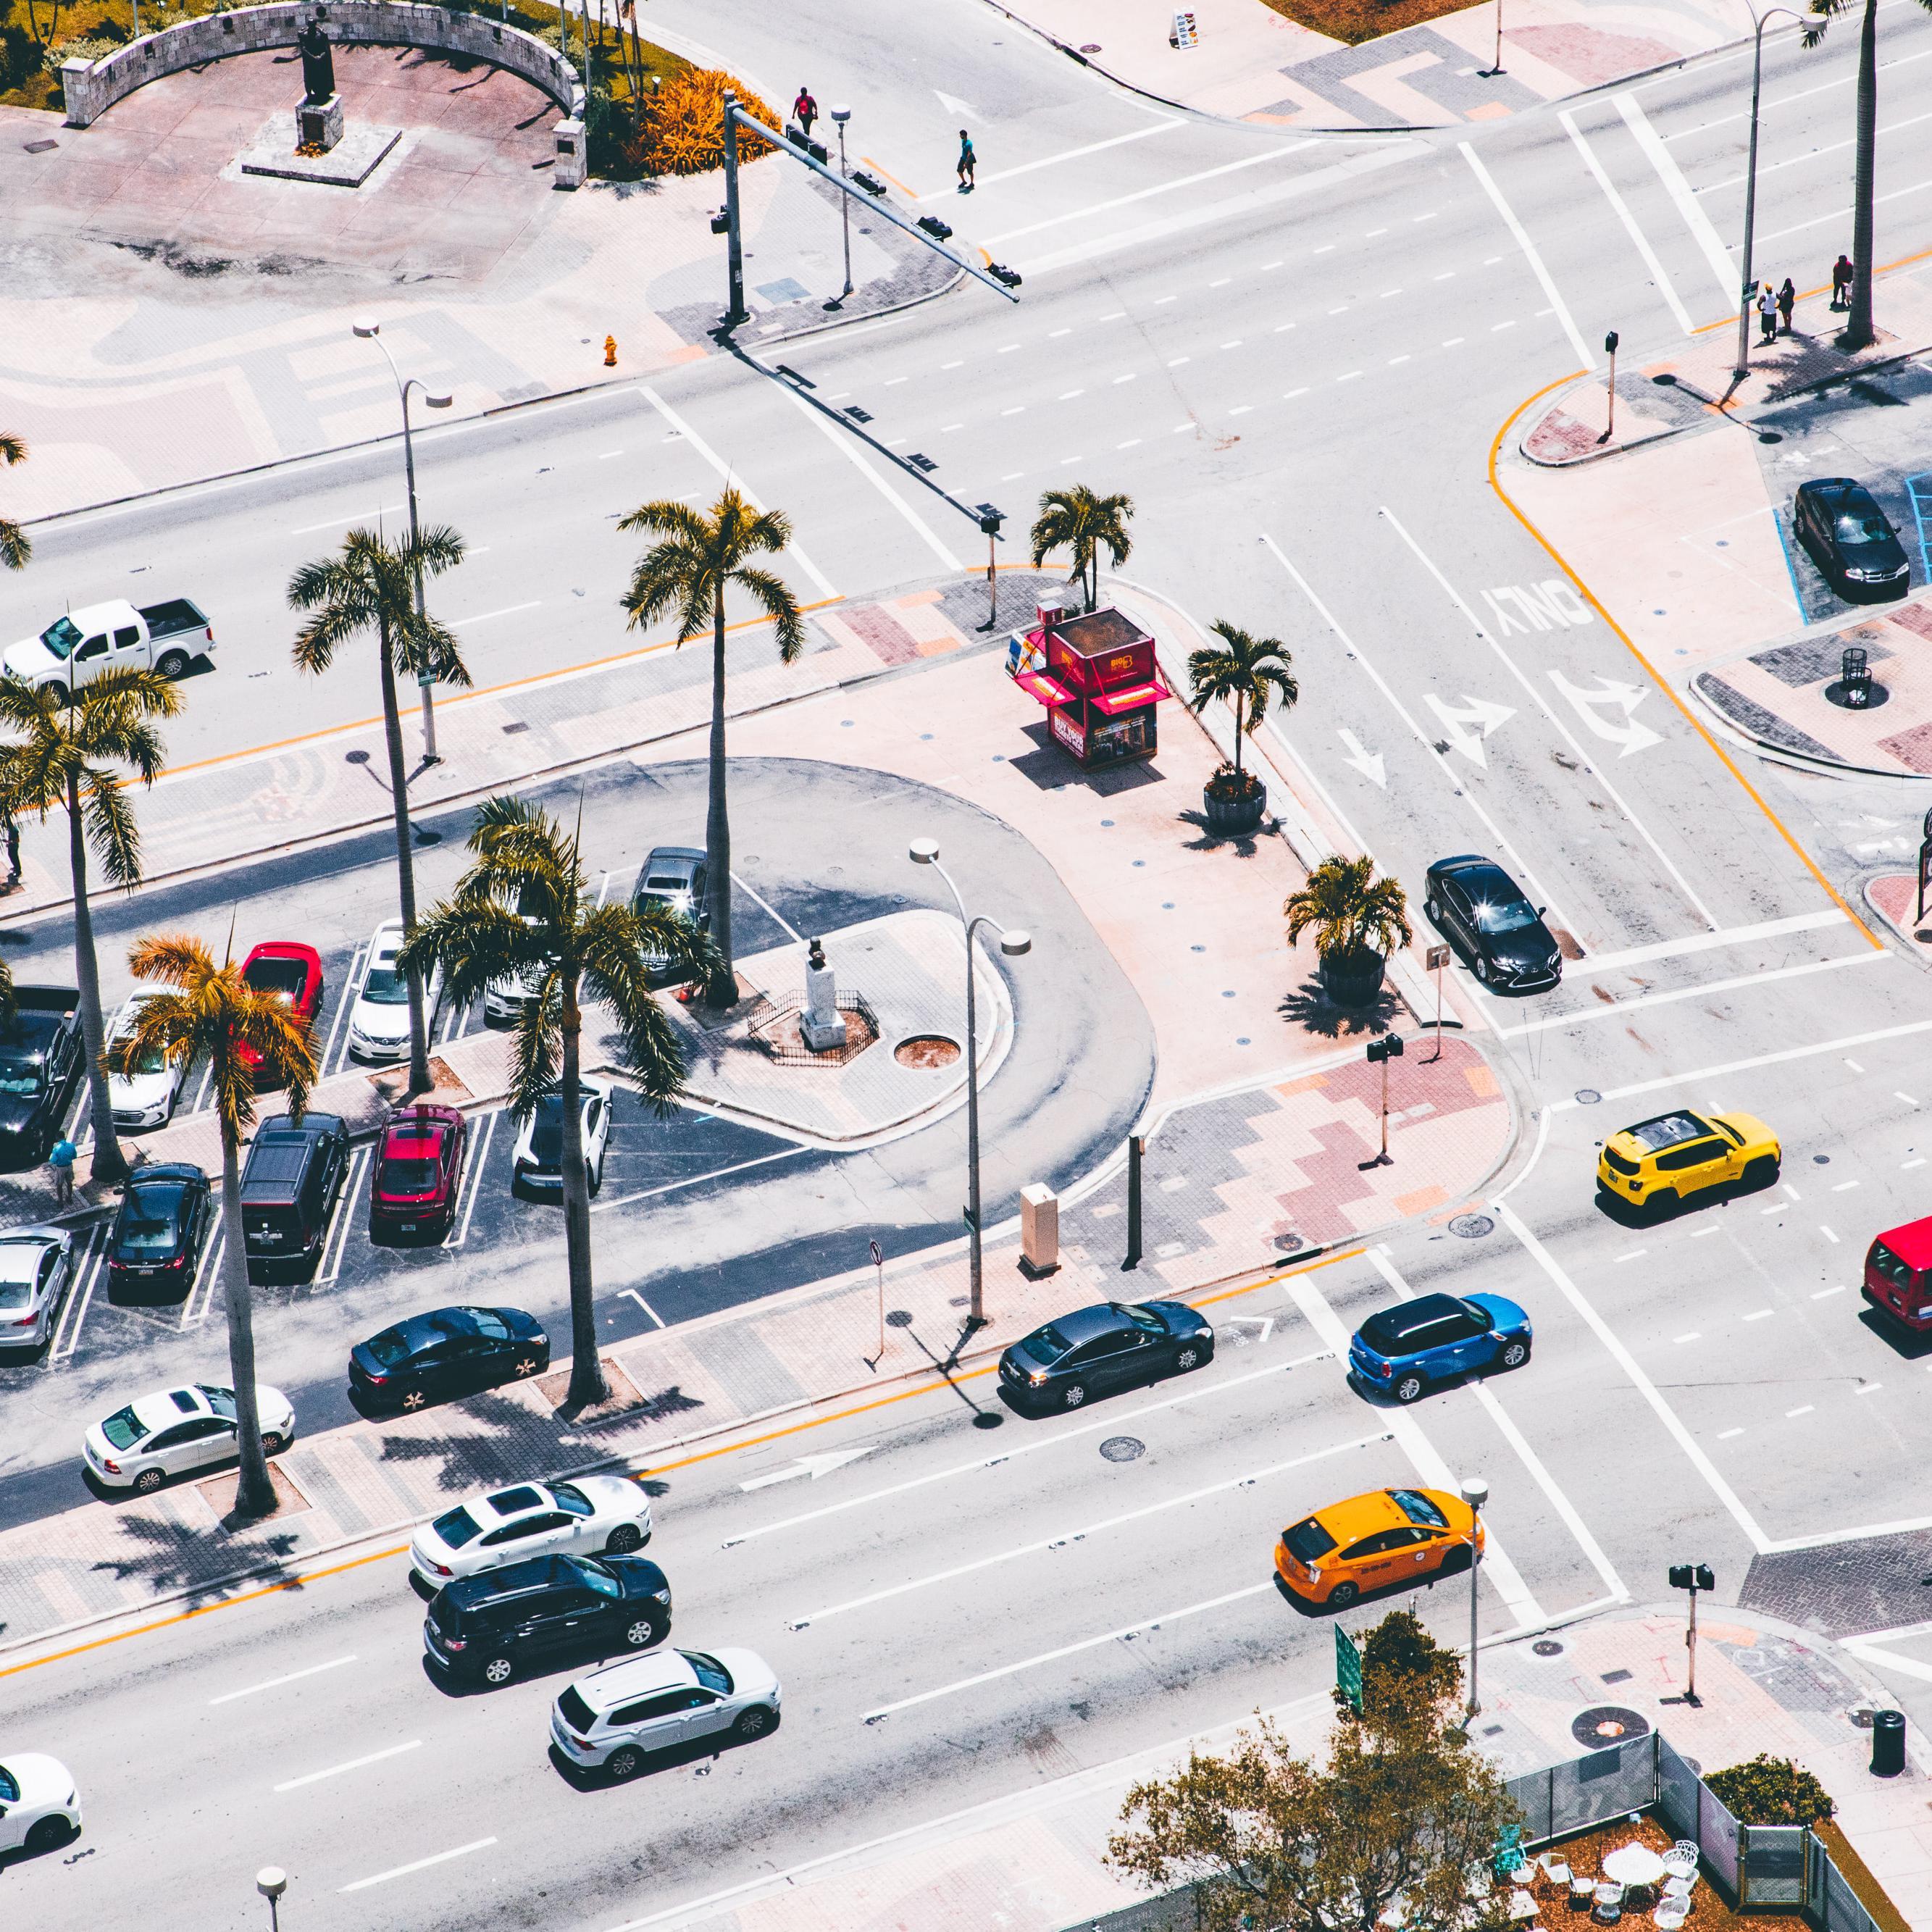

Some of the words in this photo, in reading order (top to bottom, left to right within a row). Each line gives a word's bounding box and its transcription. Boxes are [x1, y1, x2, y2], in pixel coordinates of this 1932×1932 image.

[1479, 580, 1594, 637] ONLY
[1055, 716, 1067, 732] BUY
[1067, 726, 1084, 747] YOUR
